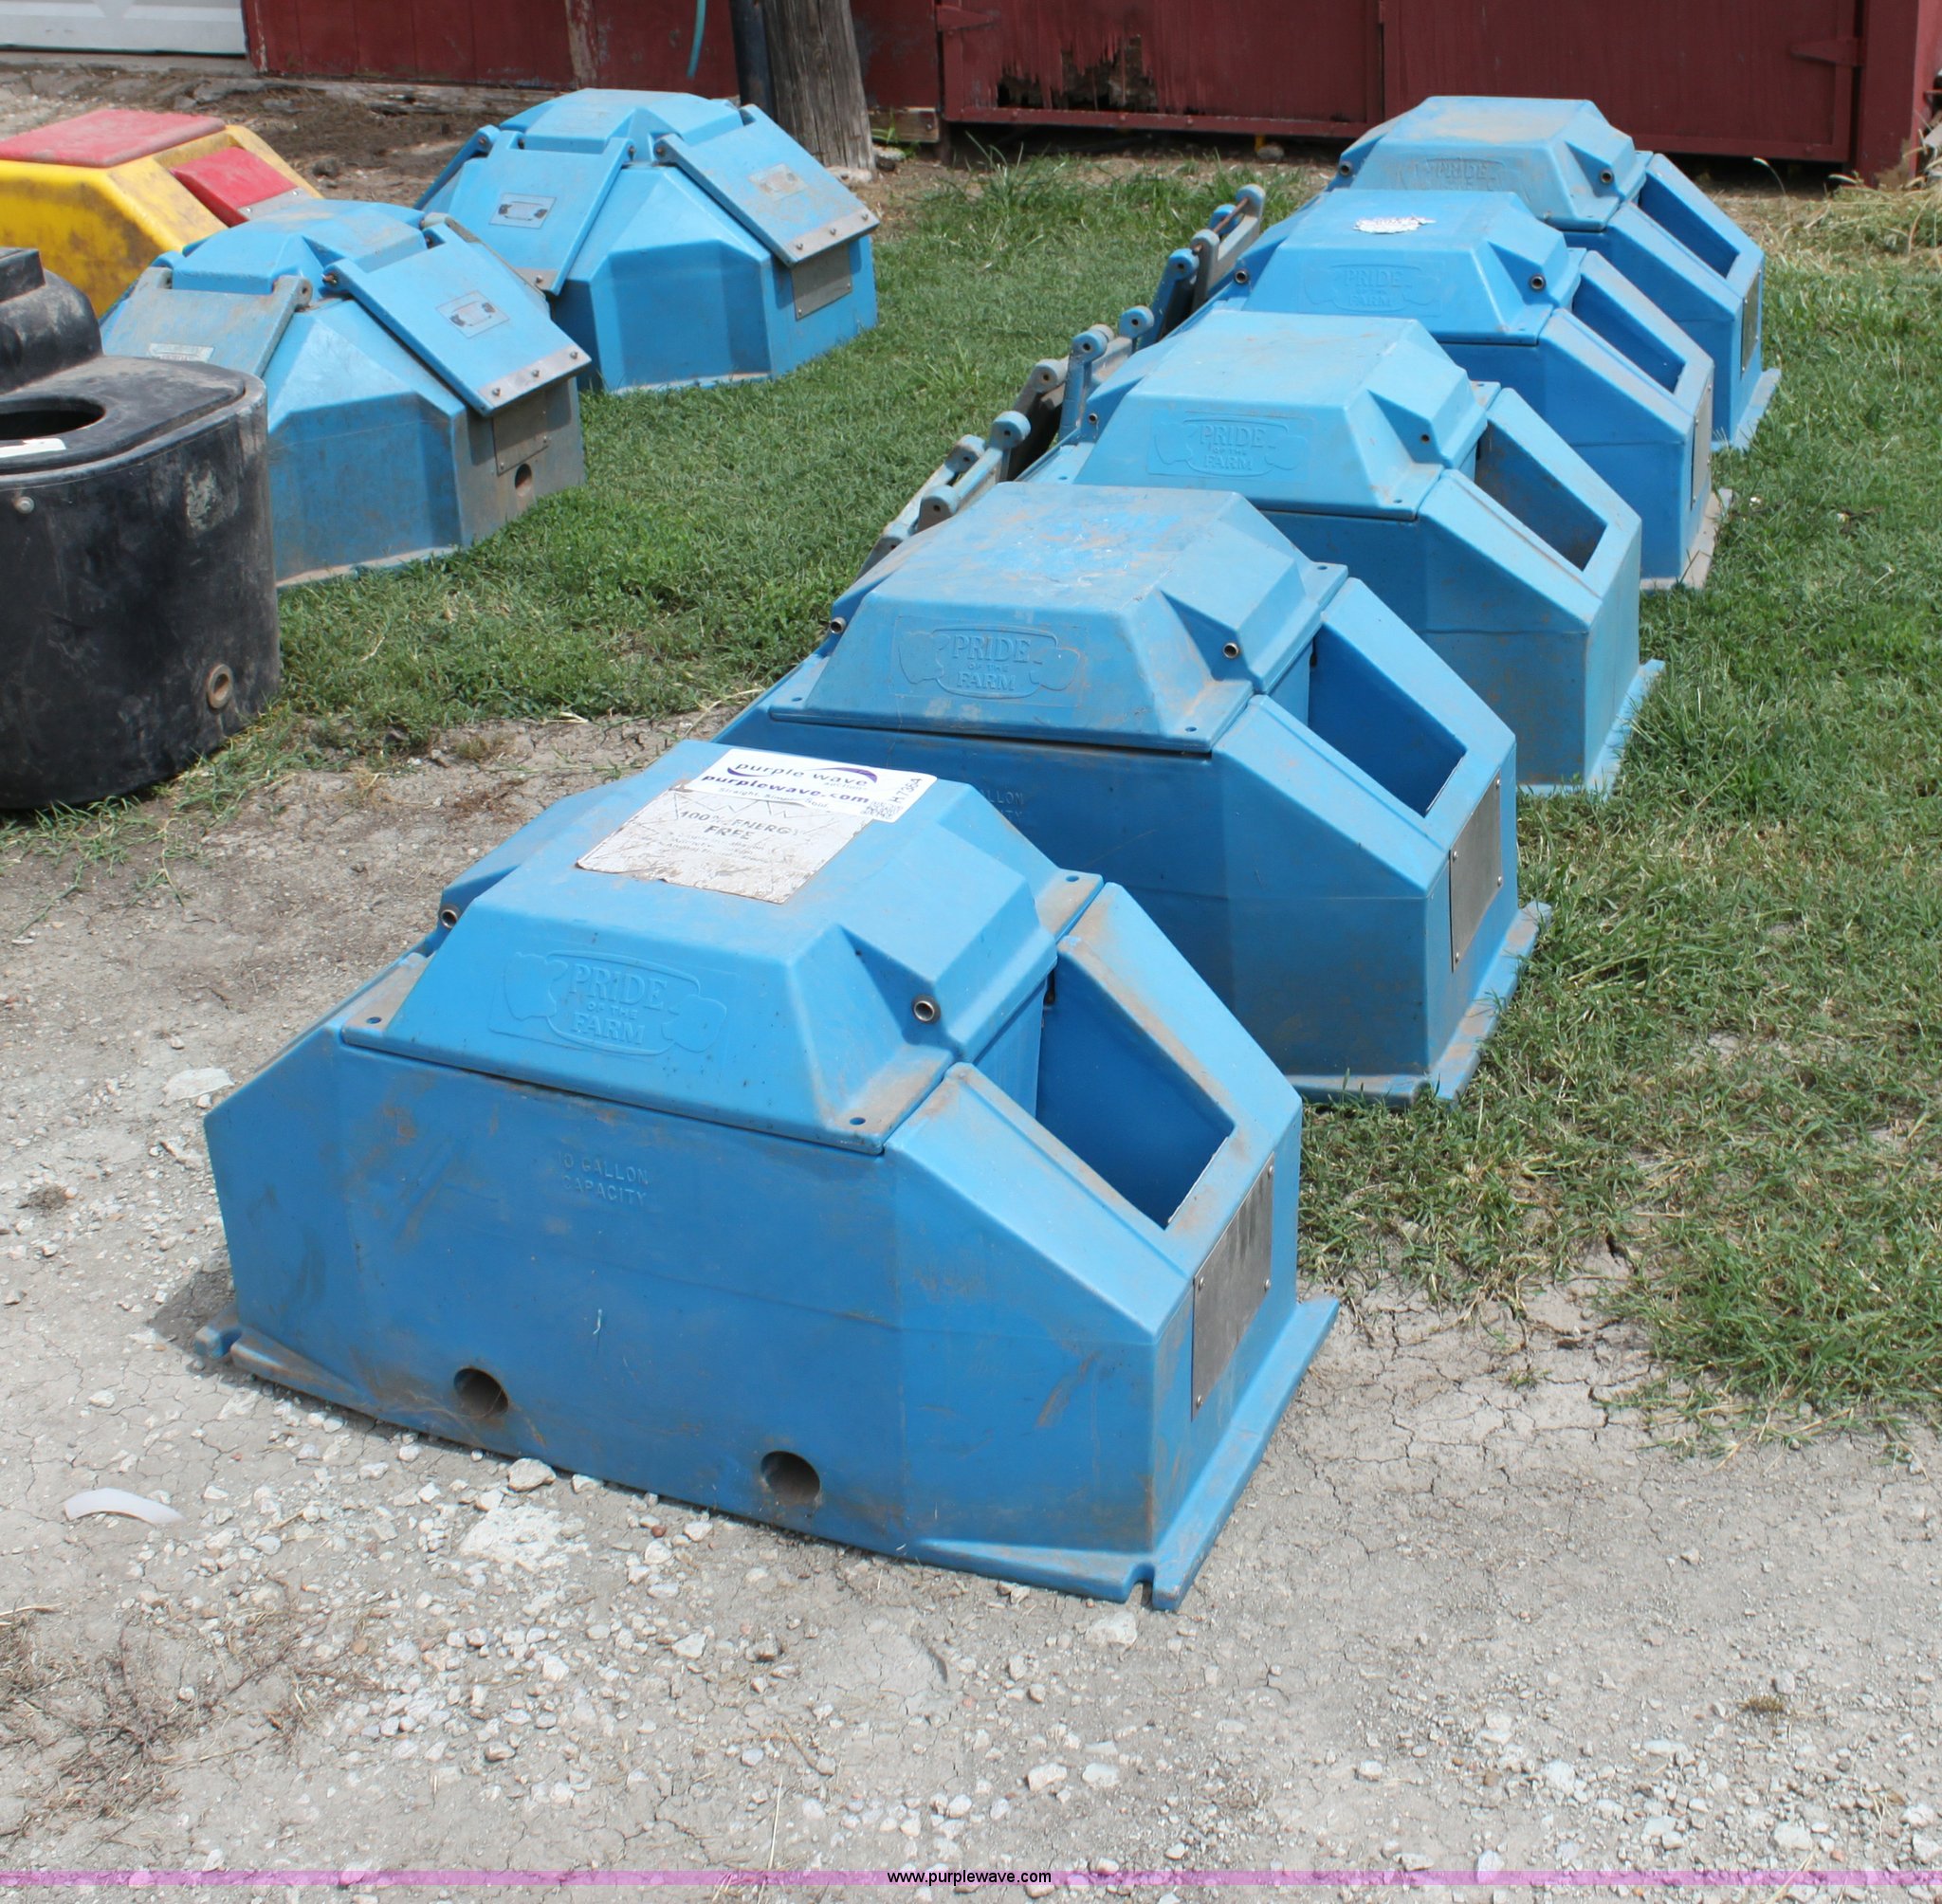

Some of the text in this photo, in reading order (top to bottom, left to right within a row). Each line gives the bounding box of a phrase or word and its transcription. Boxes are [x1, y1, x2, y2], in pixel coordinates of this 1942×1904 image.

[1345, 268, 1403, 287] PRIDE
[1200, 426, 1266, 448] PRIDE
[1203, 454, 1253, 470] FARM
[951, 634, 1032, 664] PRIDE
[957, 671, 1017, 690] FARM
[736, 761, 869, 787] purple wave
[701, 775, 870, 804] purplewave.com
[704, 824, 757, 841] FREE
[569, 963, 668, 1012] PRIDE
[586, 1002, 639, 1021] OF THE
[572, 1012, 646, 1045] FARM
[582, 1157, 649, 1185] GALLON
[562, 1175, 648, 1207] CAPACITY
